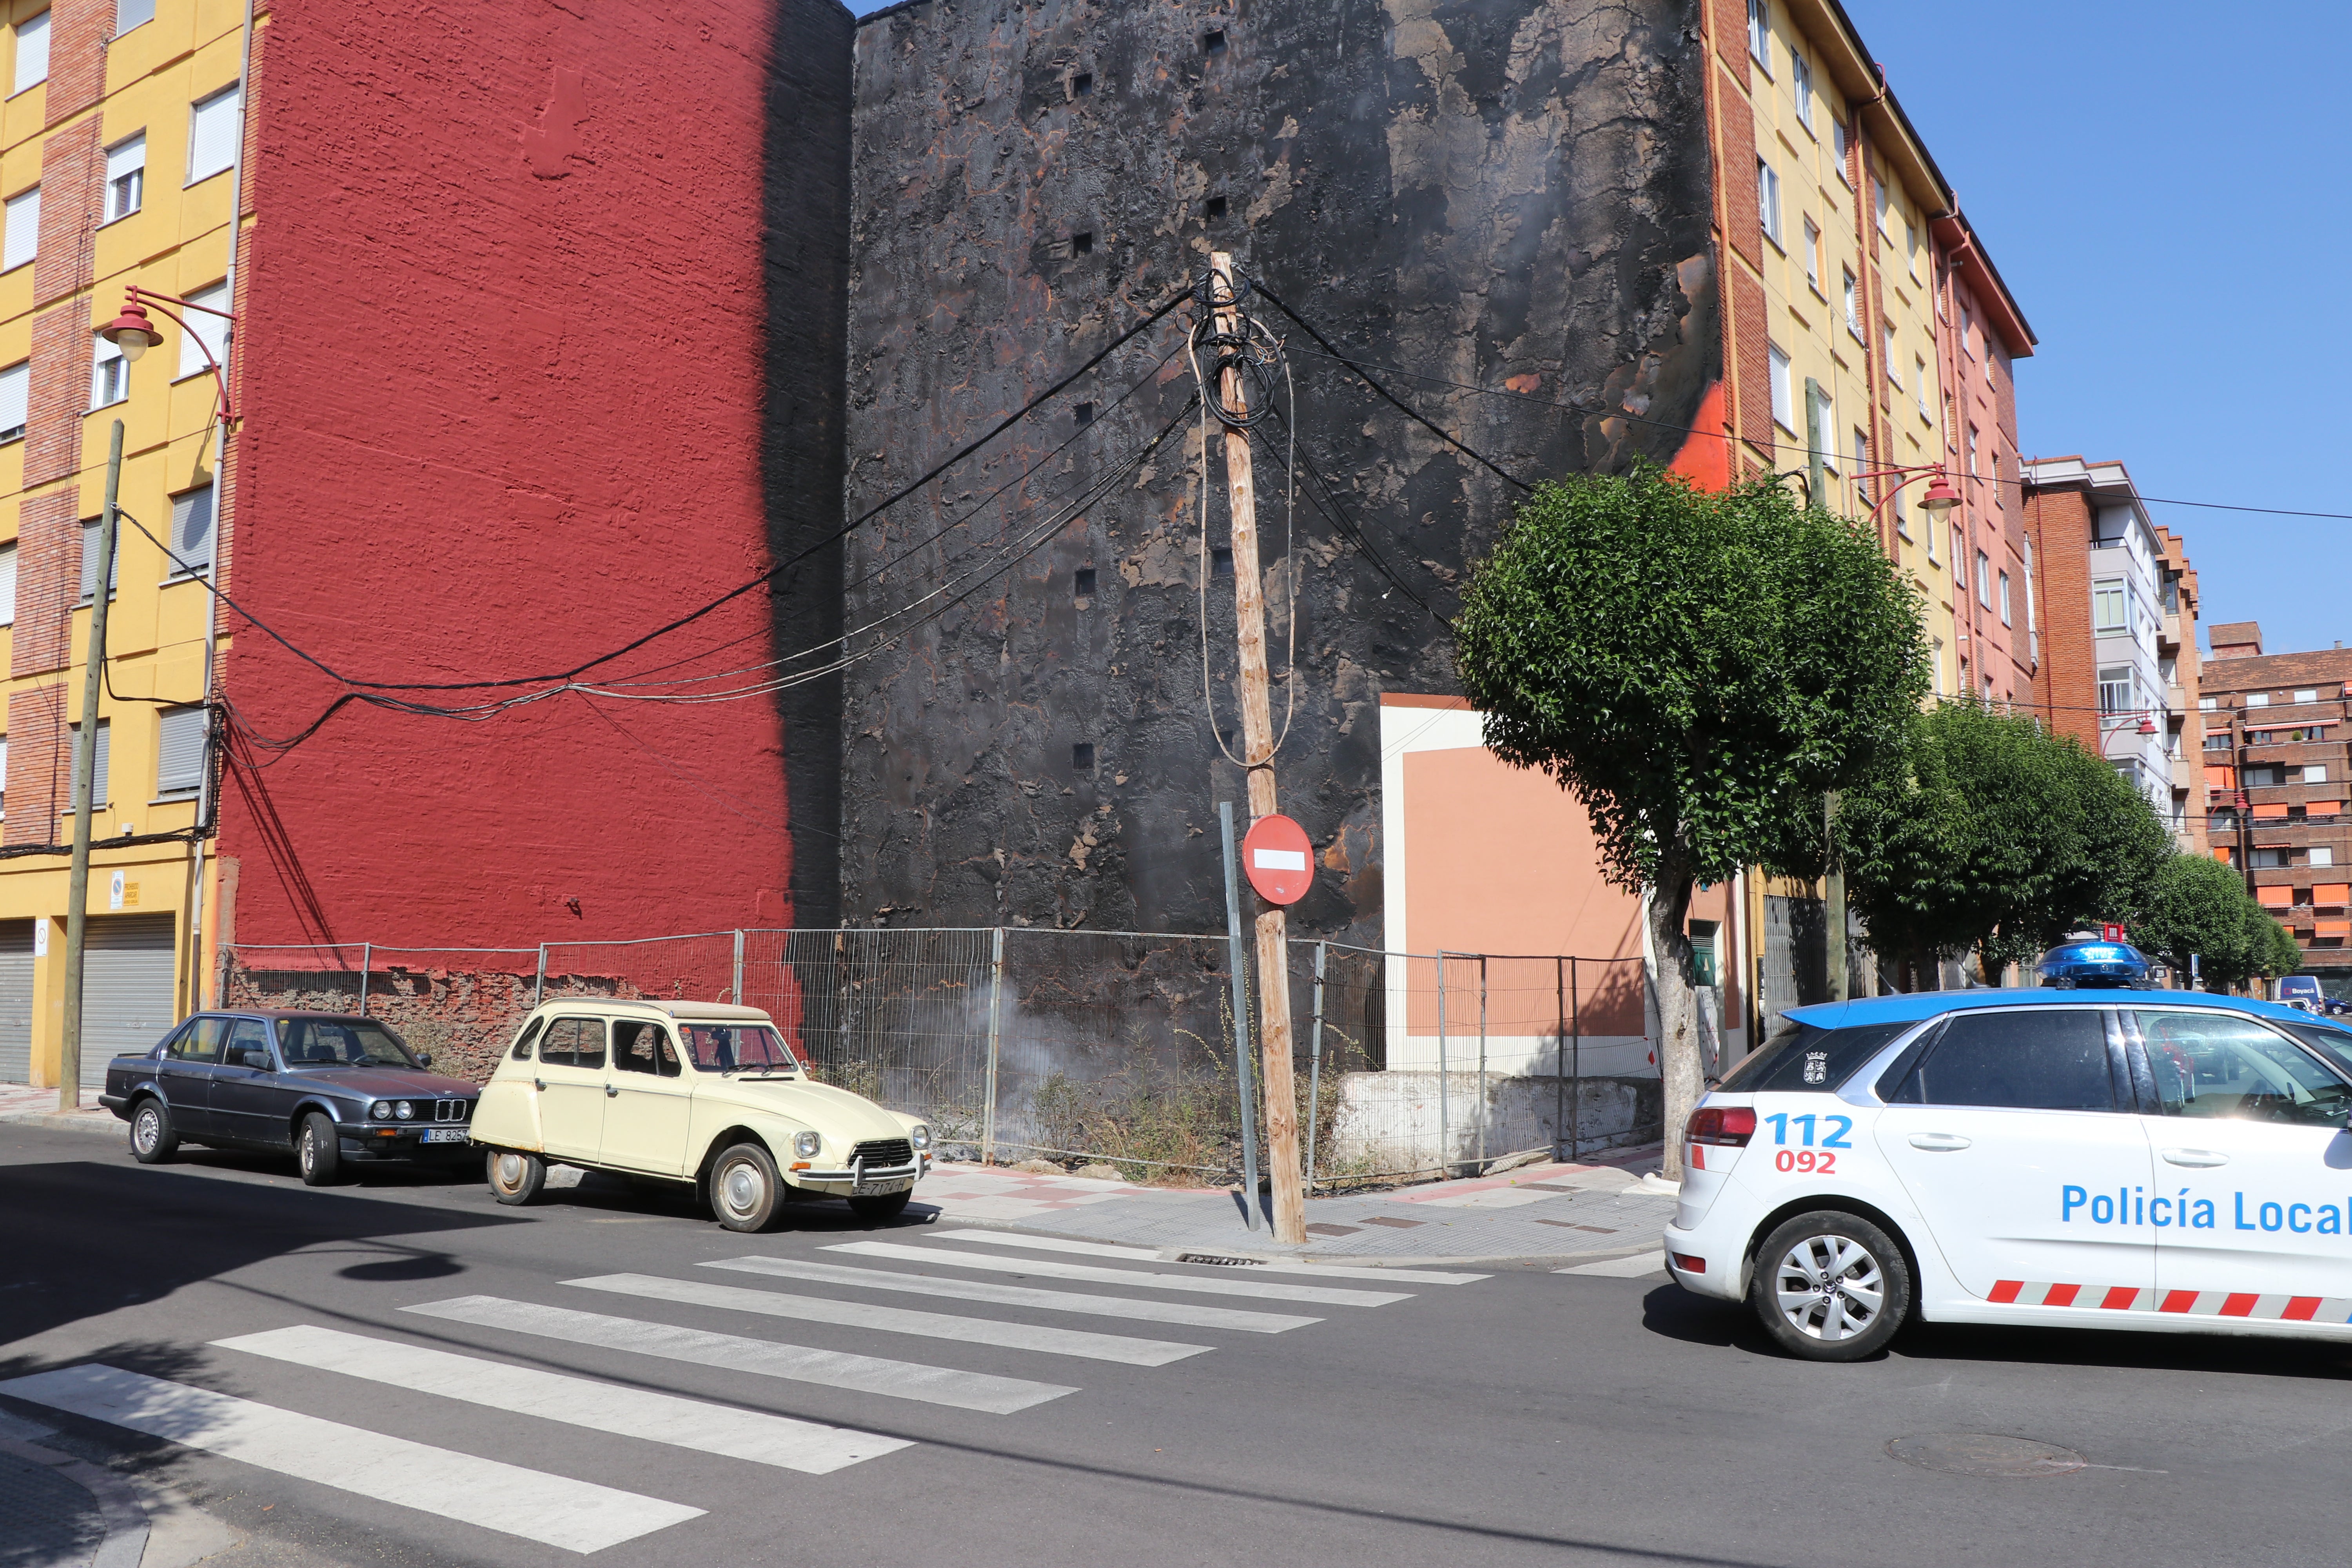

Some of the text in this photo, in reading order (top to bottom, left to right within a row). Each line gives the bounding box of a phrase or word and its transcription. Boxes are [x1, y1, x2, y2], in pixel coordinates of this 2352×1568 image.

[429, 1131, 441, 1141] LE
[1764, 1113, 1853, 1149] 112
[1775, 1150, 1836, 1174] 092
[2062, 1185, 2215, 1229] Policía
